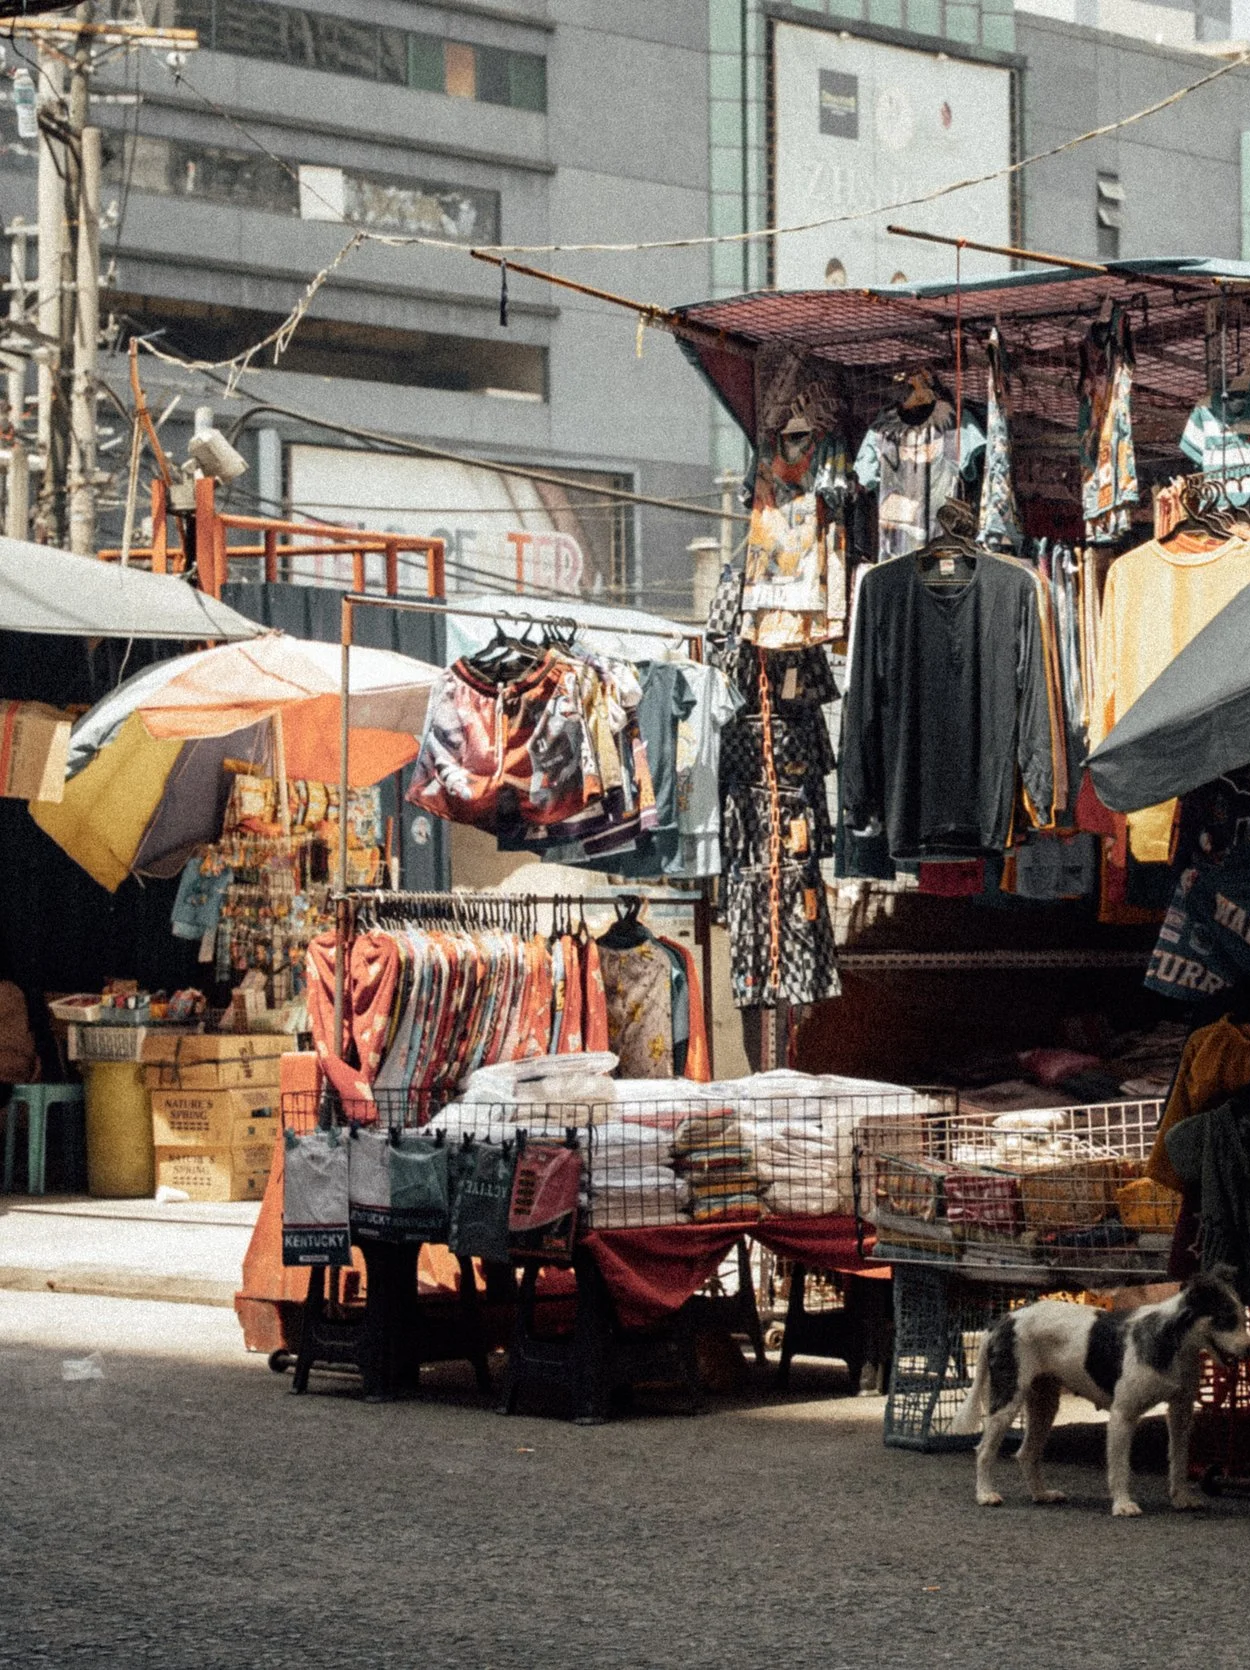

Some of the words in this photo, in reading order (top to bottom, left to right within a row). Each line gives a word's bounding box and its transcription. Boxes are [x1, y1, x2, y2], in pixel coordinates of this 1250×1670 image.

[169, 1110, 208, 1120] SPRING
[464, 1179, 509, 1199] ACTIVE
[285, 1231, 346, 1248] KENTUCKY
